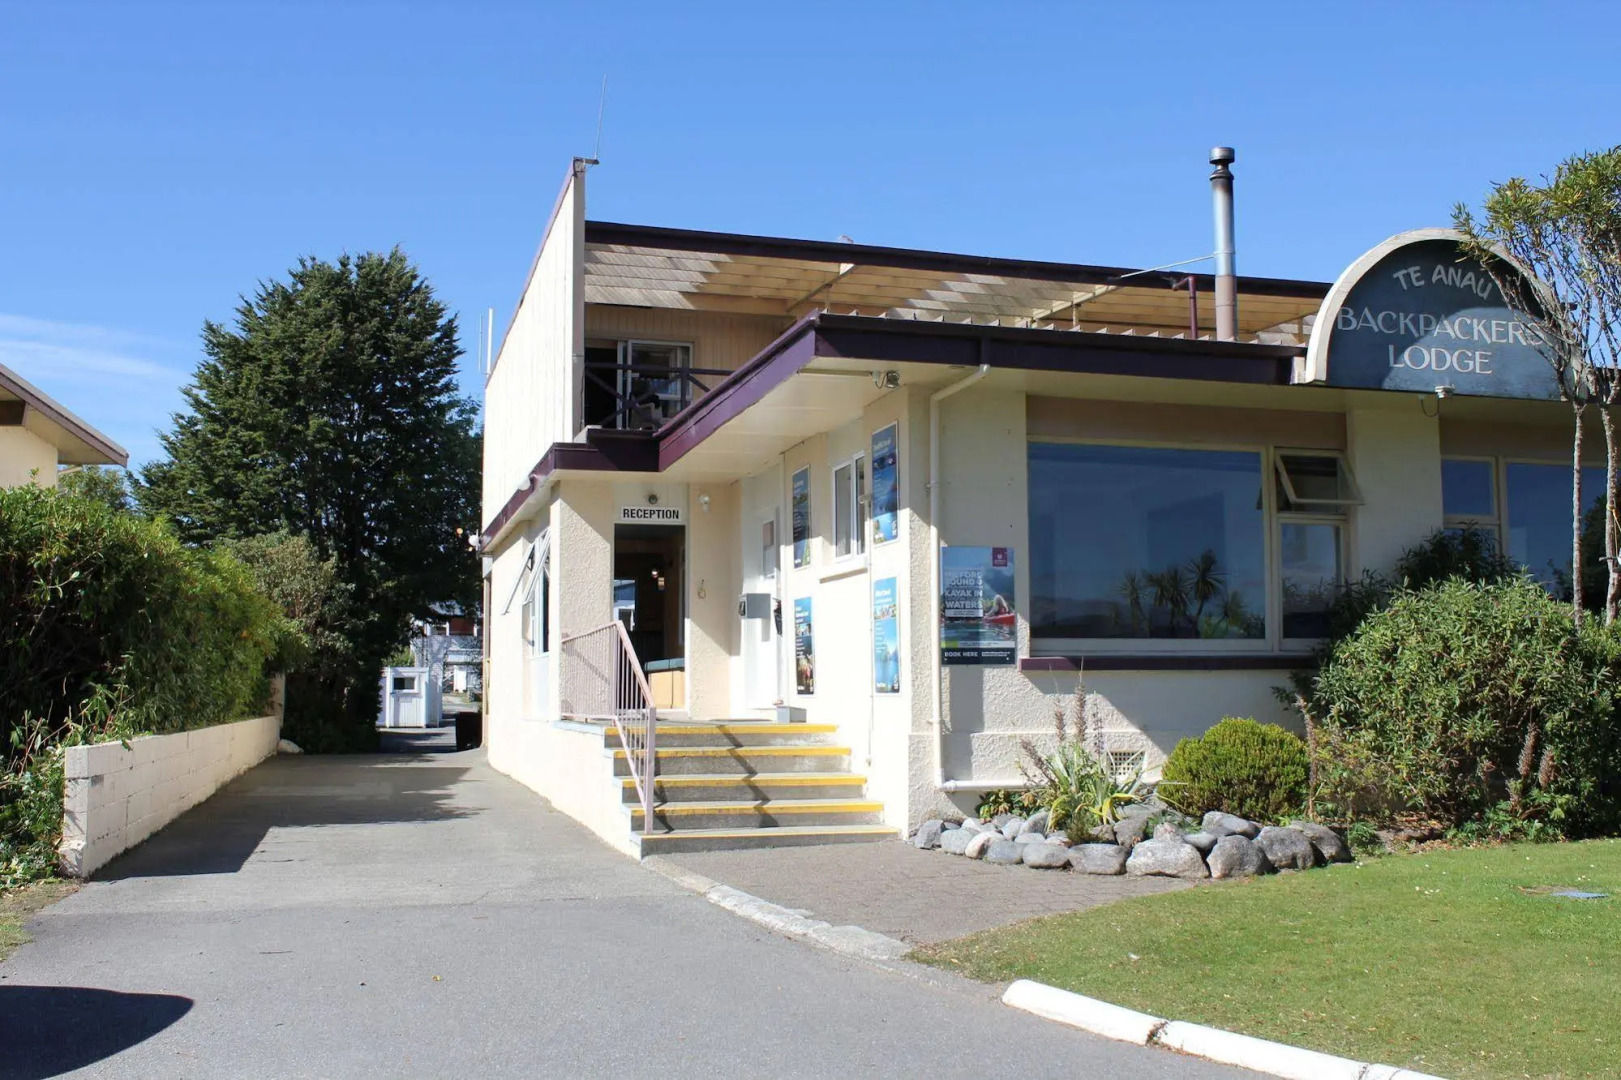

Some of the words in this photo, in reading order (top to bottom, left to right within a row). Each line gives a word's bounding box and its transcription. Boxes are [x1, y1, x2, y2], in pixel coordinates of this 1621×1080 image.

[1393, 265, 1425, 291] TE
[1431, 264, 1493, 300] ANAU
[1337, 306, 1545, 346] BACKPACKERS
[1388, 344, 1493, 375] LODGE
[622, 508, 679, 519] RECEPTION
[945, 600, 983, 608] WATERS
